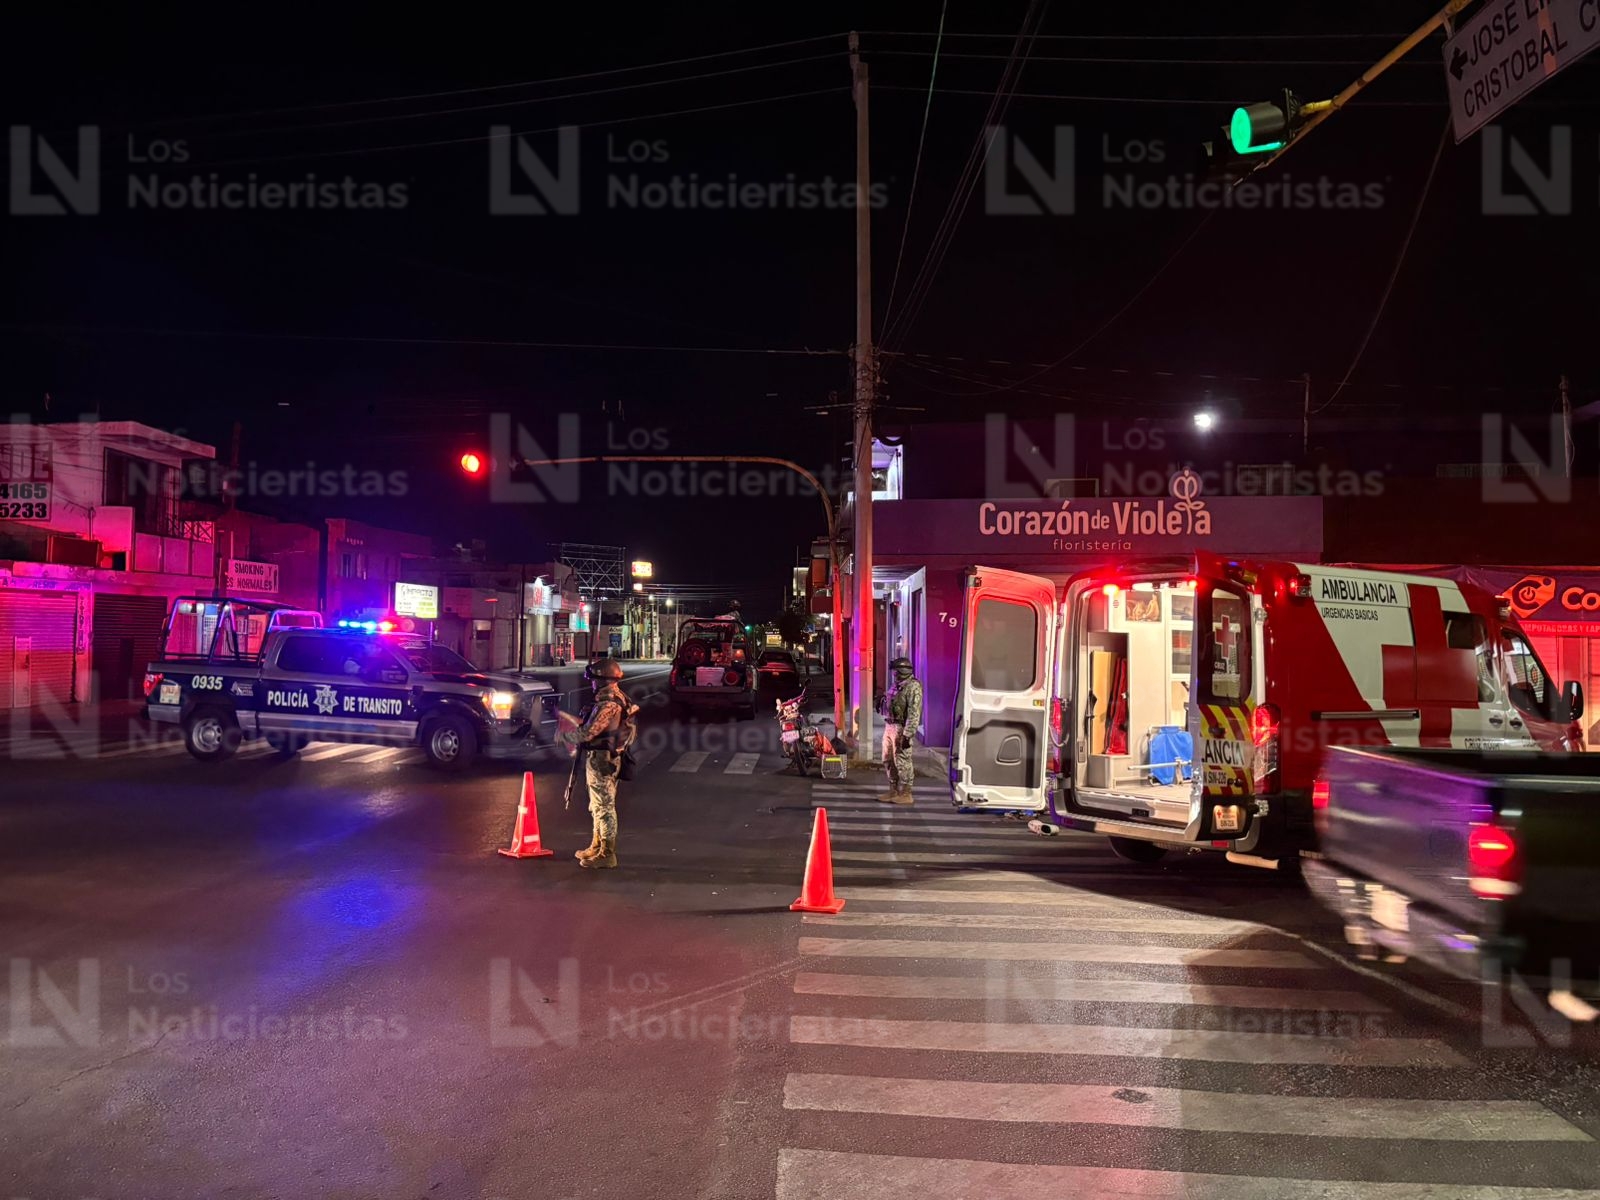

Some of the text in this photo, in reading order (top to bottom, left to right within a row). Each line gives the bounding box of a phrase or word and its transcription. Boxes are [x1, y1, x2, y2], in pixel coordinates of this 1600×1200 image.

[1470, 1, 1520, 66] JOSE
[1464, 22, 1568, 117] CRISTOBAL
[0, 483, 47, 499] 4165
[0, 502, 47, 518] 5233
[980, 498, 1212, 535] Corazón de Violeta
[1053, 539, 1132, 550] floristería
[234, 563, 264, 576] SMOKING
[1321, 578, 1398, 604] AMBULANCIA
[1321, 607, 1379, 621] URGENCIAS BASICAS
[192, 675, 224, 690] 0935
[267, 689, 402, 715] POLICÍA DE TRANSITO
